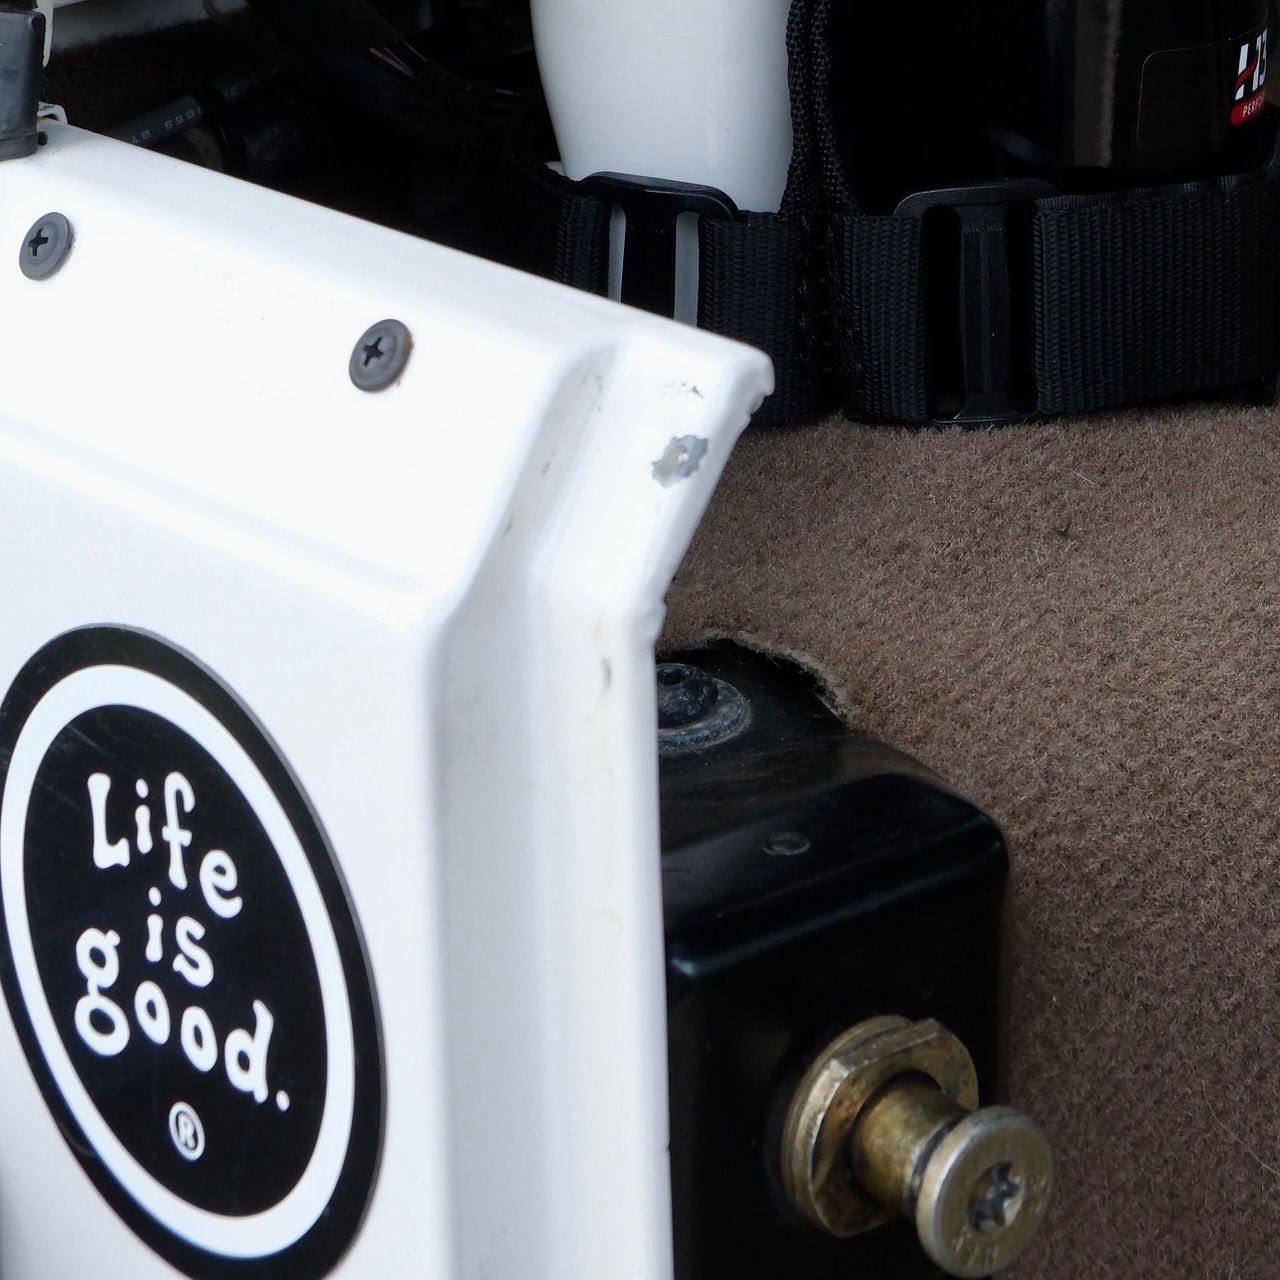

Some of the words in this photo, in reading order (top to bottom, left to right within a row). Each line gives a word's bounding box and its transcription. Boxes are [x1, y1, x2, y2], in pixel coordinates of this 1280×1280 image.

[87, 772, 243, 919] Life
[146, 887, 215, 988] is
[74, 927, 290, 1113] good.
